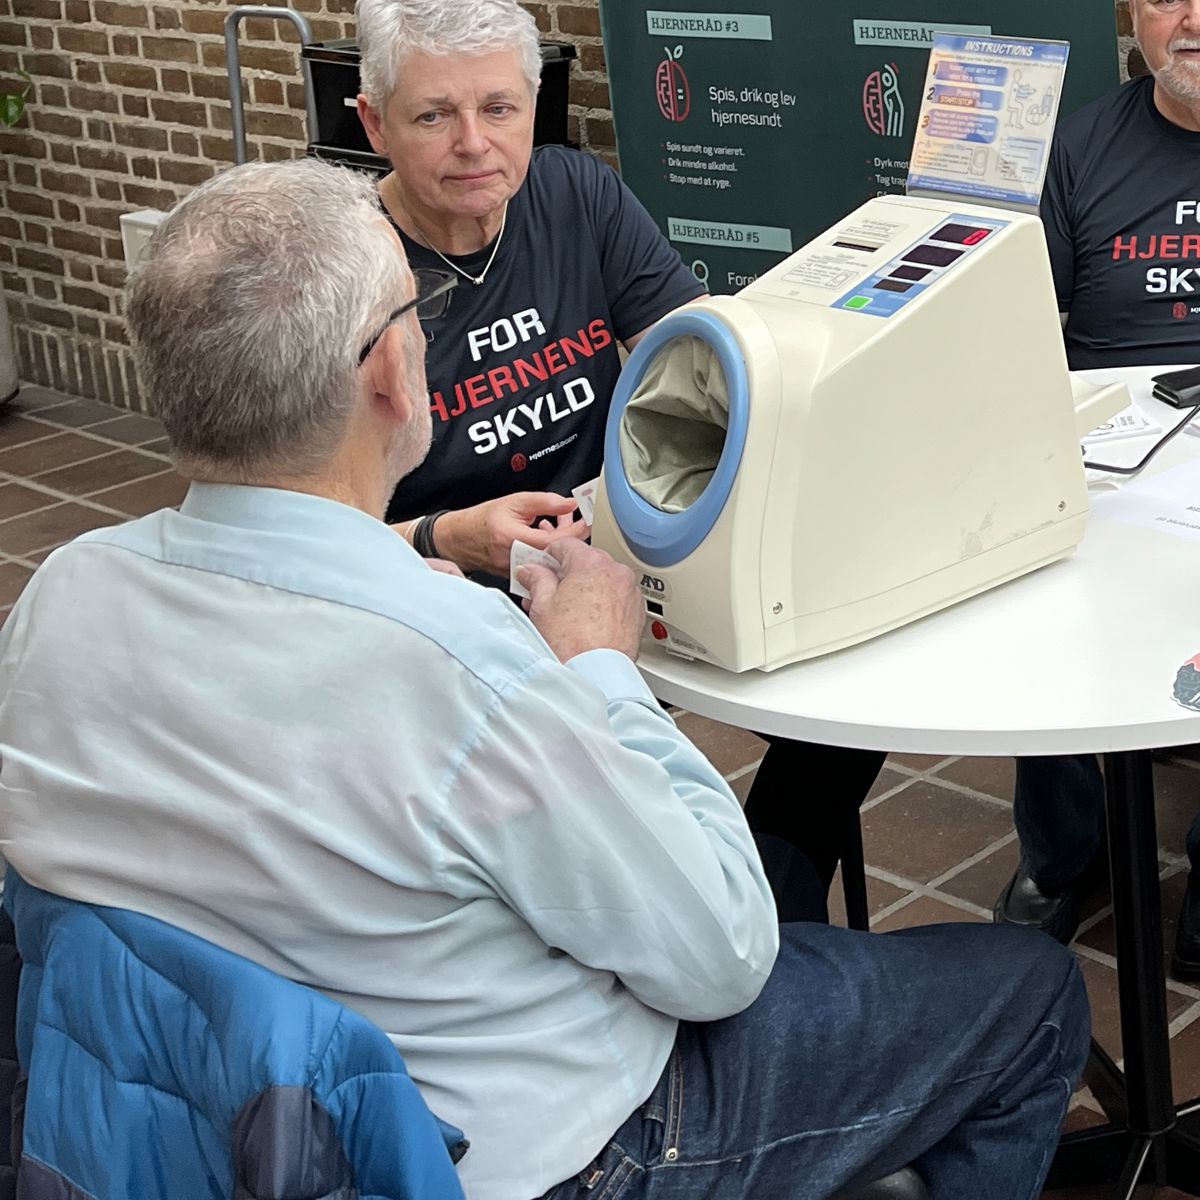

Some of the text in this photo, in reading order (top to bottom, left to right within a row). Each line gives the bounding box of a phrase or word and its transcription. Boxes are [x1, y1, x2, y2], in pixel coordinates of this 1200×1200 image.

[651, 17, 739, 33] HJERNERÅD #3
[964, 40, 1035, 57] INSTRUCTIONS
[708, 86, 797, 109] Spis, drik og lev
[926, 86, 936, 101] 2
[711, 108, 783, 128] hjernesundt
[921, 115, 931, 128] 3
[665, 141, 681, 153] Spis
[681, 144, 702, 154] sundt
[702, 146, 713, 156] og
[668, 157, 682, 167] Drik
[682, 160, 707, 170] mindre
[874, 156, 893, 170] Dyrk
[669, 172, 686, 185] Stop
[686, 176, 703, 186] med
[703, 177, 712, 186] at
[875, 174, 890, 187] Tag
[673, 223, 760, 243] HJERNERÅD #5
[467, 307, 546, 362] FOR
[430, 319, 612, 423] HJERNENS
[468, 377, 595, 455] SKYLD
